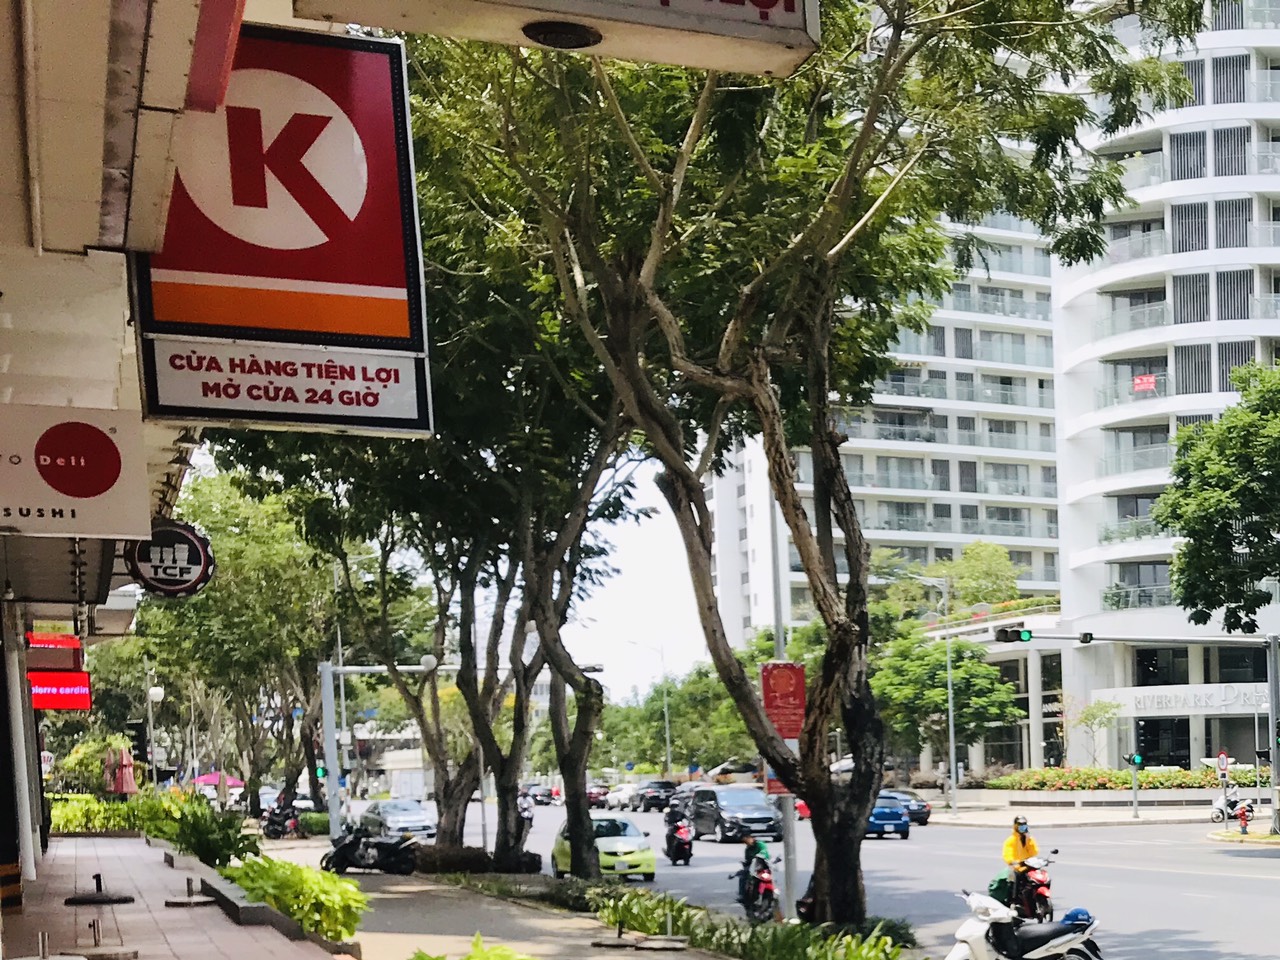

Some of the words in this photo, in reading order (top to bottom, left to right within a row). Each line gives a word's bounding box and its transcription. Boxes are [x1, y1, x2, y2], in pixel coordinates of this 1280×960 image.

[225, 106, 354, 241] K
[169, 350, 223, 373] CỬA
[229, 355, 298, 377] HÀNG
[302, 359, 355, 385] TIỆN
[362, 366, 400, 389] LỢI
[247, 381, 299, 403] CỬA
[305, 388, 334, 404] 24
[338, 386, 379, 407] GIỜ
[40, 455, 85, 467] Deli
[3, 507, 76, 518] SUSHI
[150, 565, 192, 578] TCF
[59, 686, 89, 695] cardin
[1134, 692, 1215, 711] RIVERPARK
